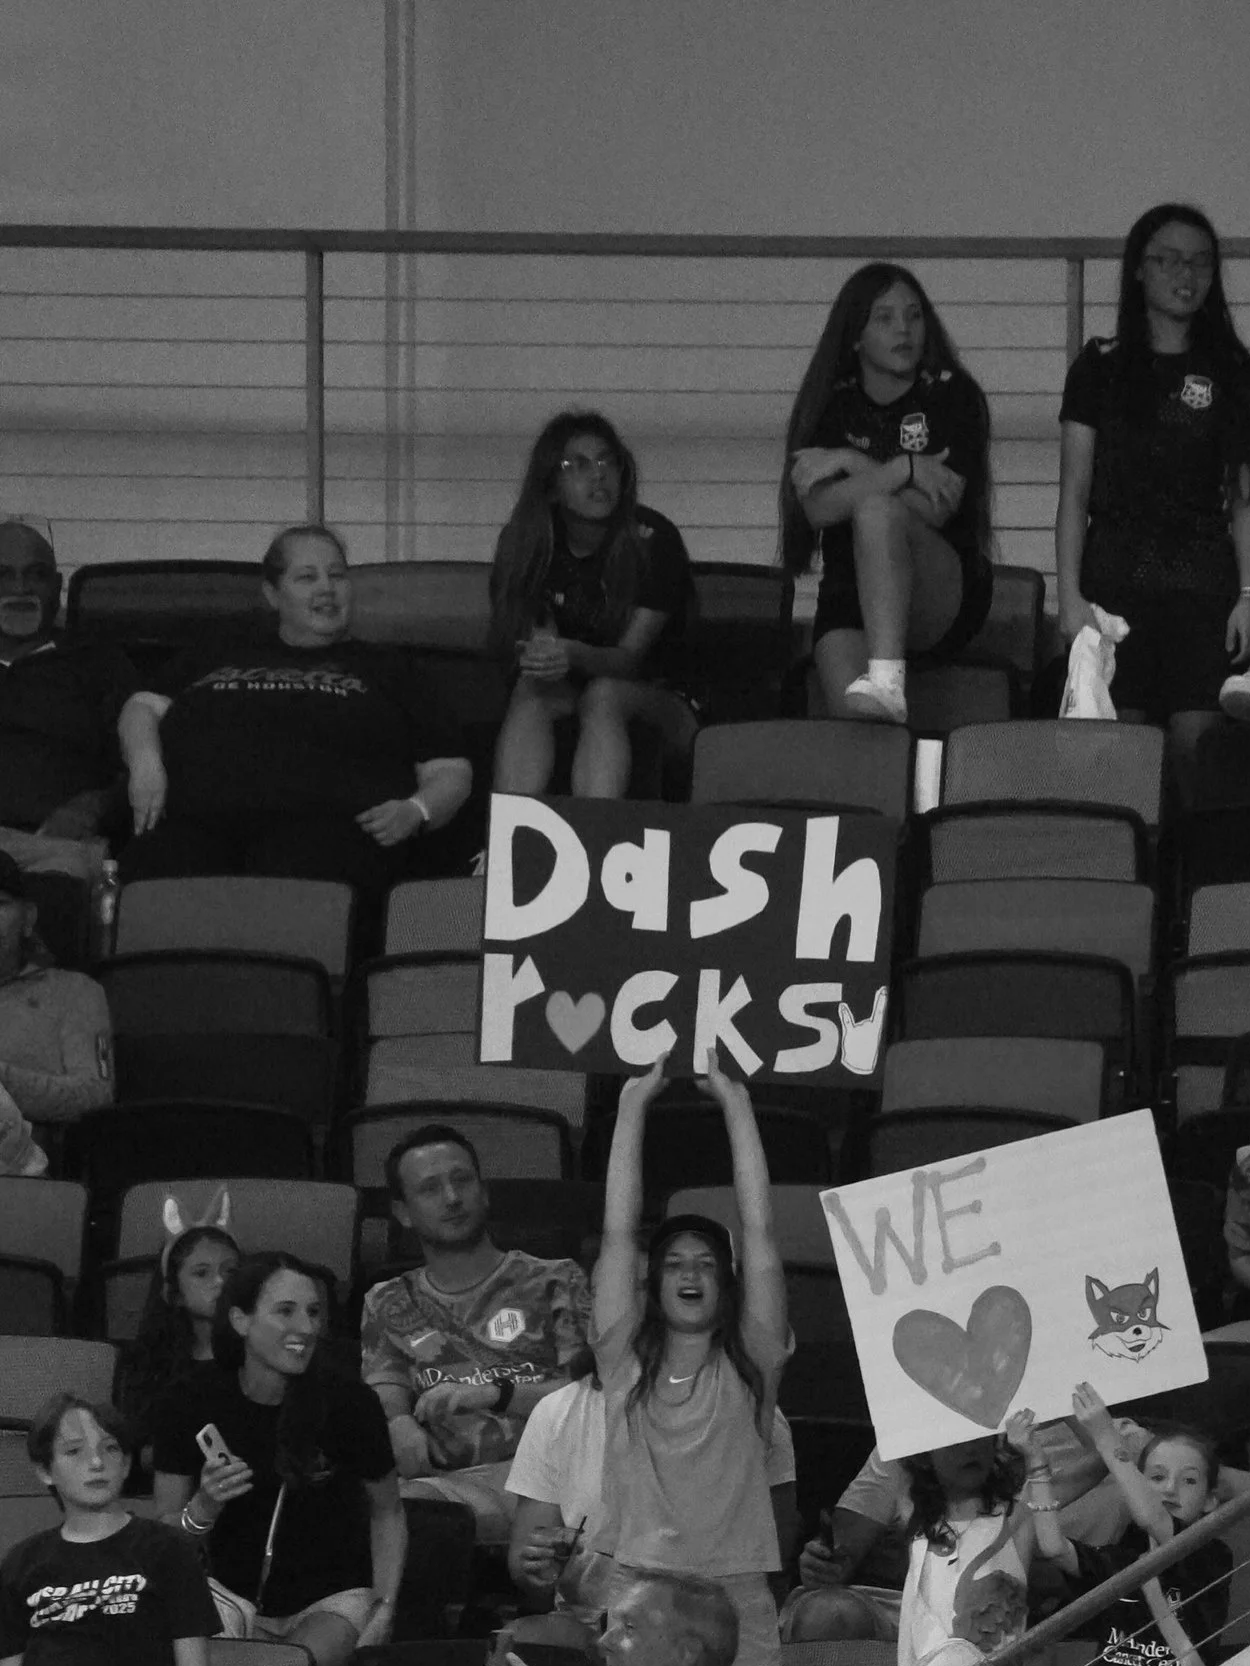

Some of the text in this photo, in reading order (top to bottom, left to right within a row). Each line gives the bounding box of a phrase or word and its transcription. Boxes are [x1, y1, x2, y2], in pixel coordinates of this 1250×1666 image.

[484, 792, 882, 963] Dash
[823, 1156, 1001, 1296] WE
[102, 1602, 136, 1615] 2025
